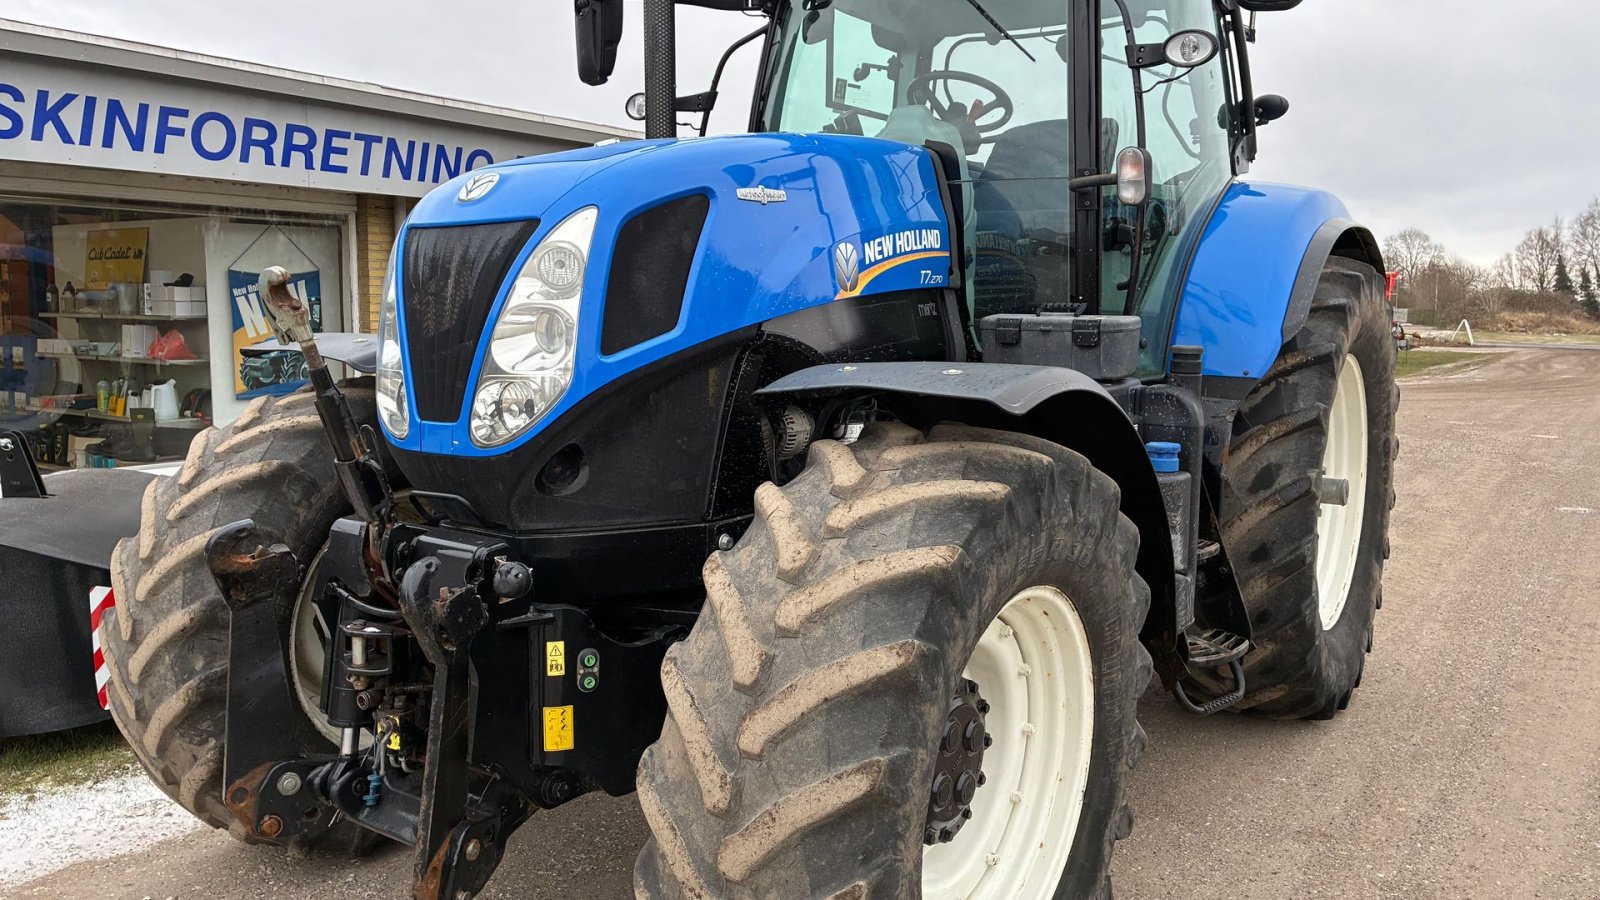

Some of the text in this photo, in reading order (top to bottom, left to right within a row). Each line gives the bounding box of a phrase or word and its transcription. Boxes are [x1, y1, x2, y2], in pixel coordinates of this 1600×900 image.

[88, 247, 104, 260] Cub
[104, 245, 131, 260] Cadet
[864, 229, 941, 264] NEW HOLLAND
[920, 269, 944, 285] T7.270
[232, 287, 247, 297] New
